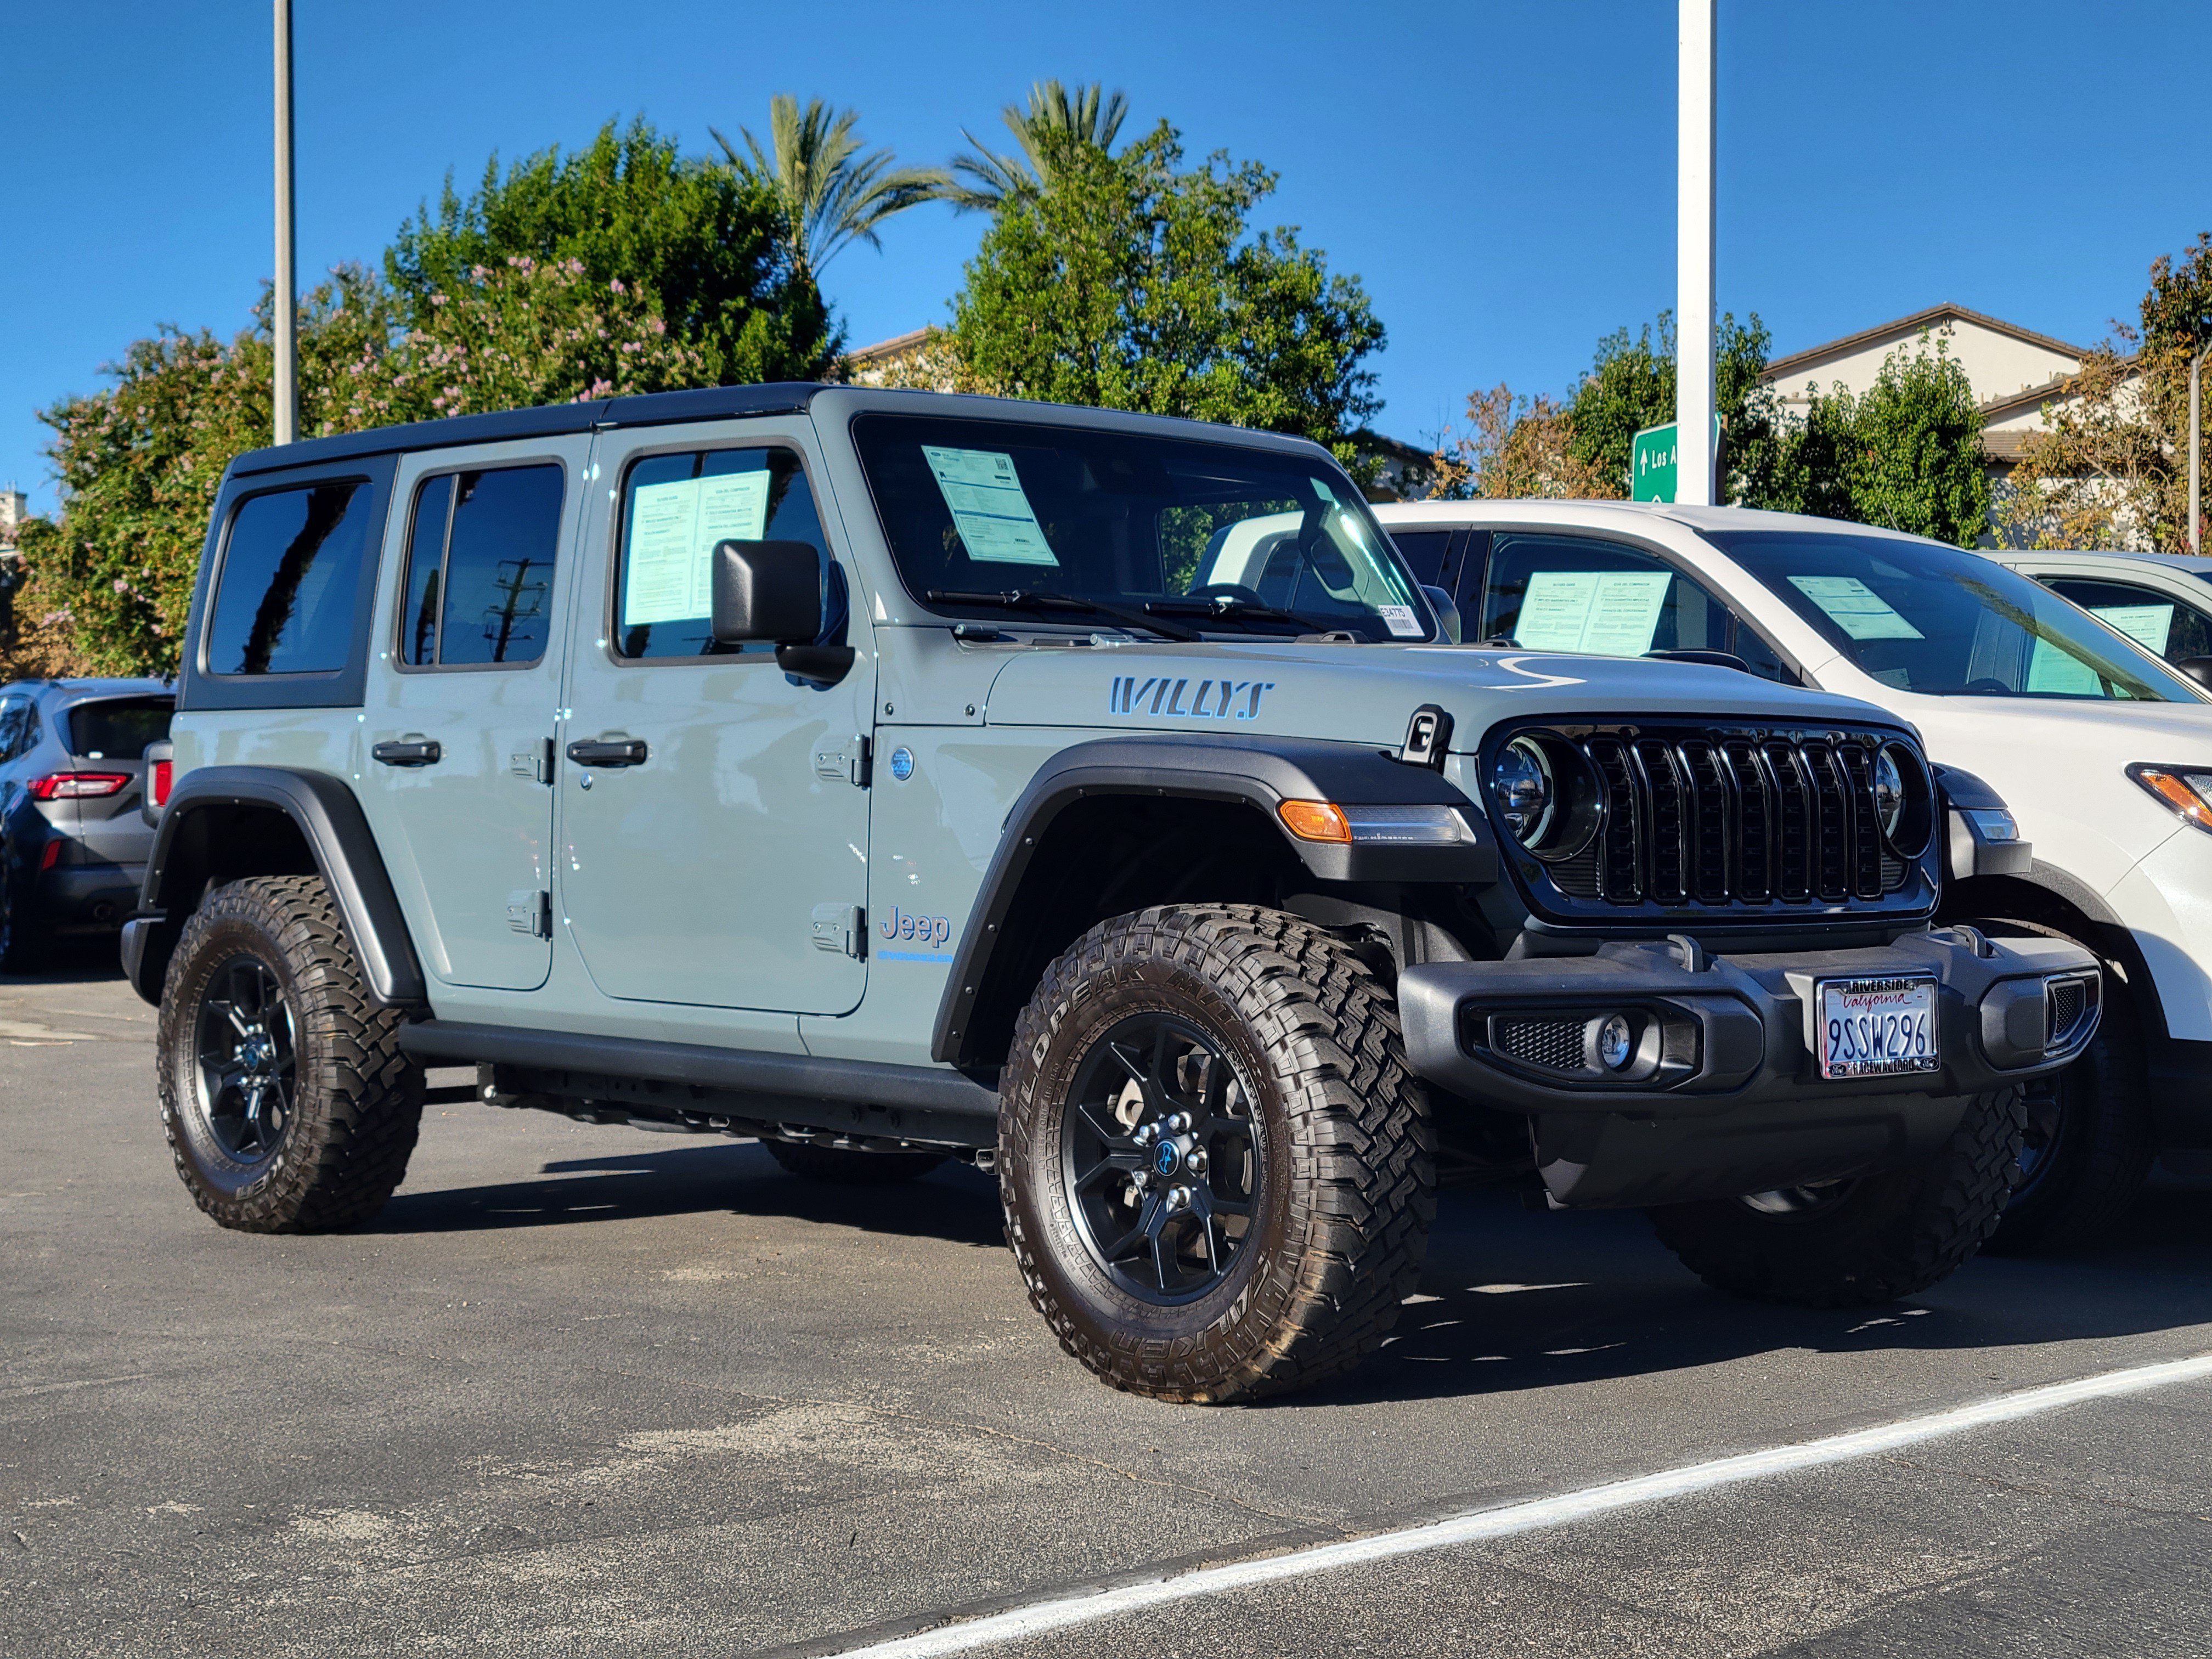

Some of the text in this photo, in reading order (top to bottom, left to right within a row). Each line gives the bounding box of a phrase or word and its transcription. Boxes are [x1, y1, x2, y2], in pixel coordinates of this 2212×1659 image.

[1651, 449, 1667, 469] Los
[1109, 675, 1276, 720] WILLYS
[879, 905, 950, 949] Jeep
[1843, 993, 1912, 1014] California
[1852, 979, 1909, 992] RIVERSIDE
[1829, 1013, 1925, 1061] 9SSW296
[1015, 960, 1150, 1176] WILDPEAK
[1831, 1058, 1936, 1075] Ford RACEWAY FORD Ford
[1109, 1248, 1272, 1359] FALKEN
